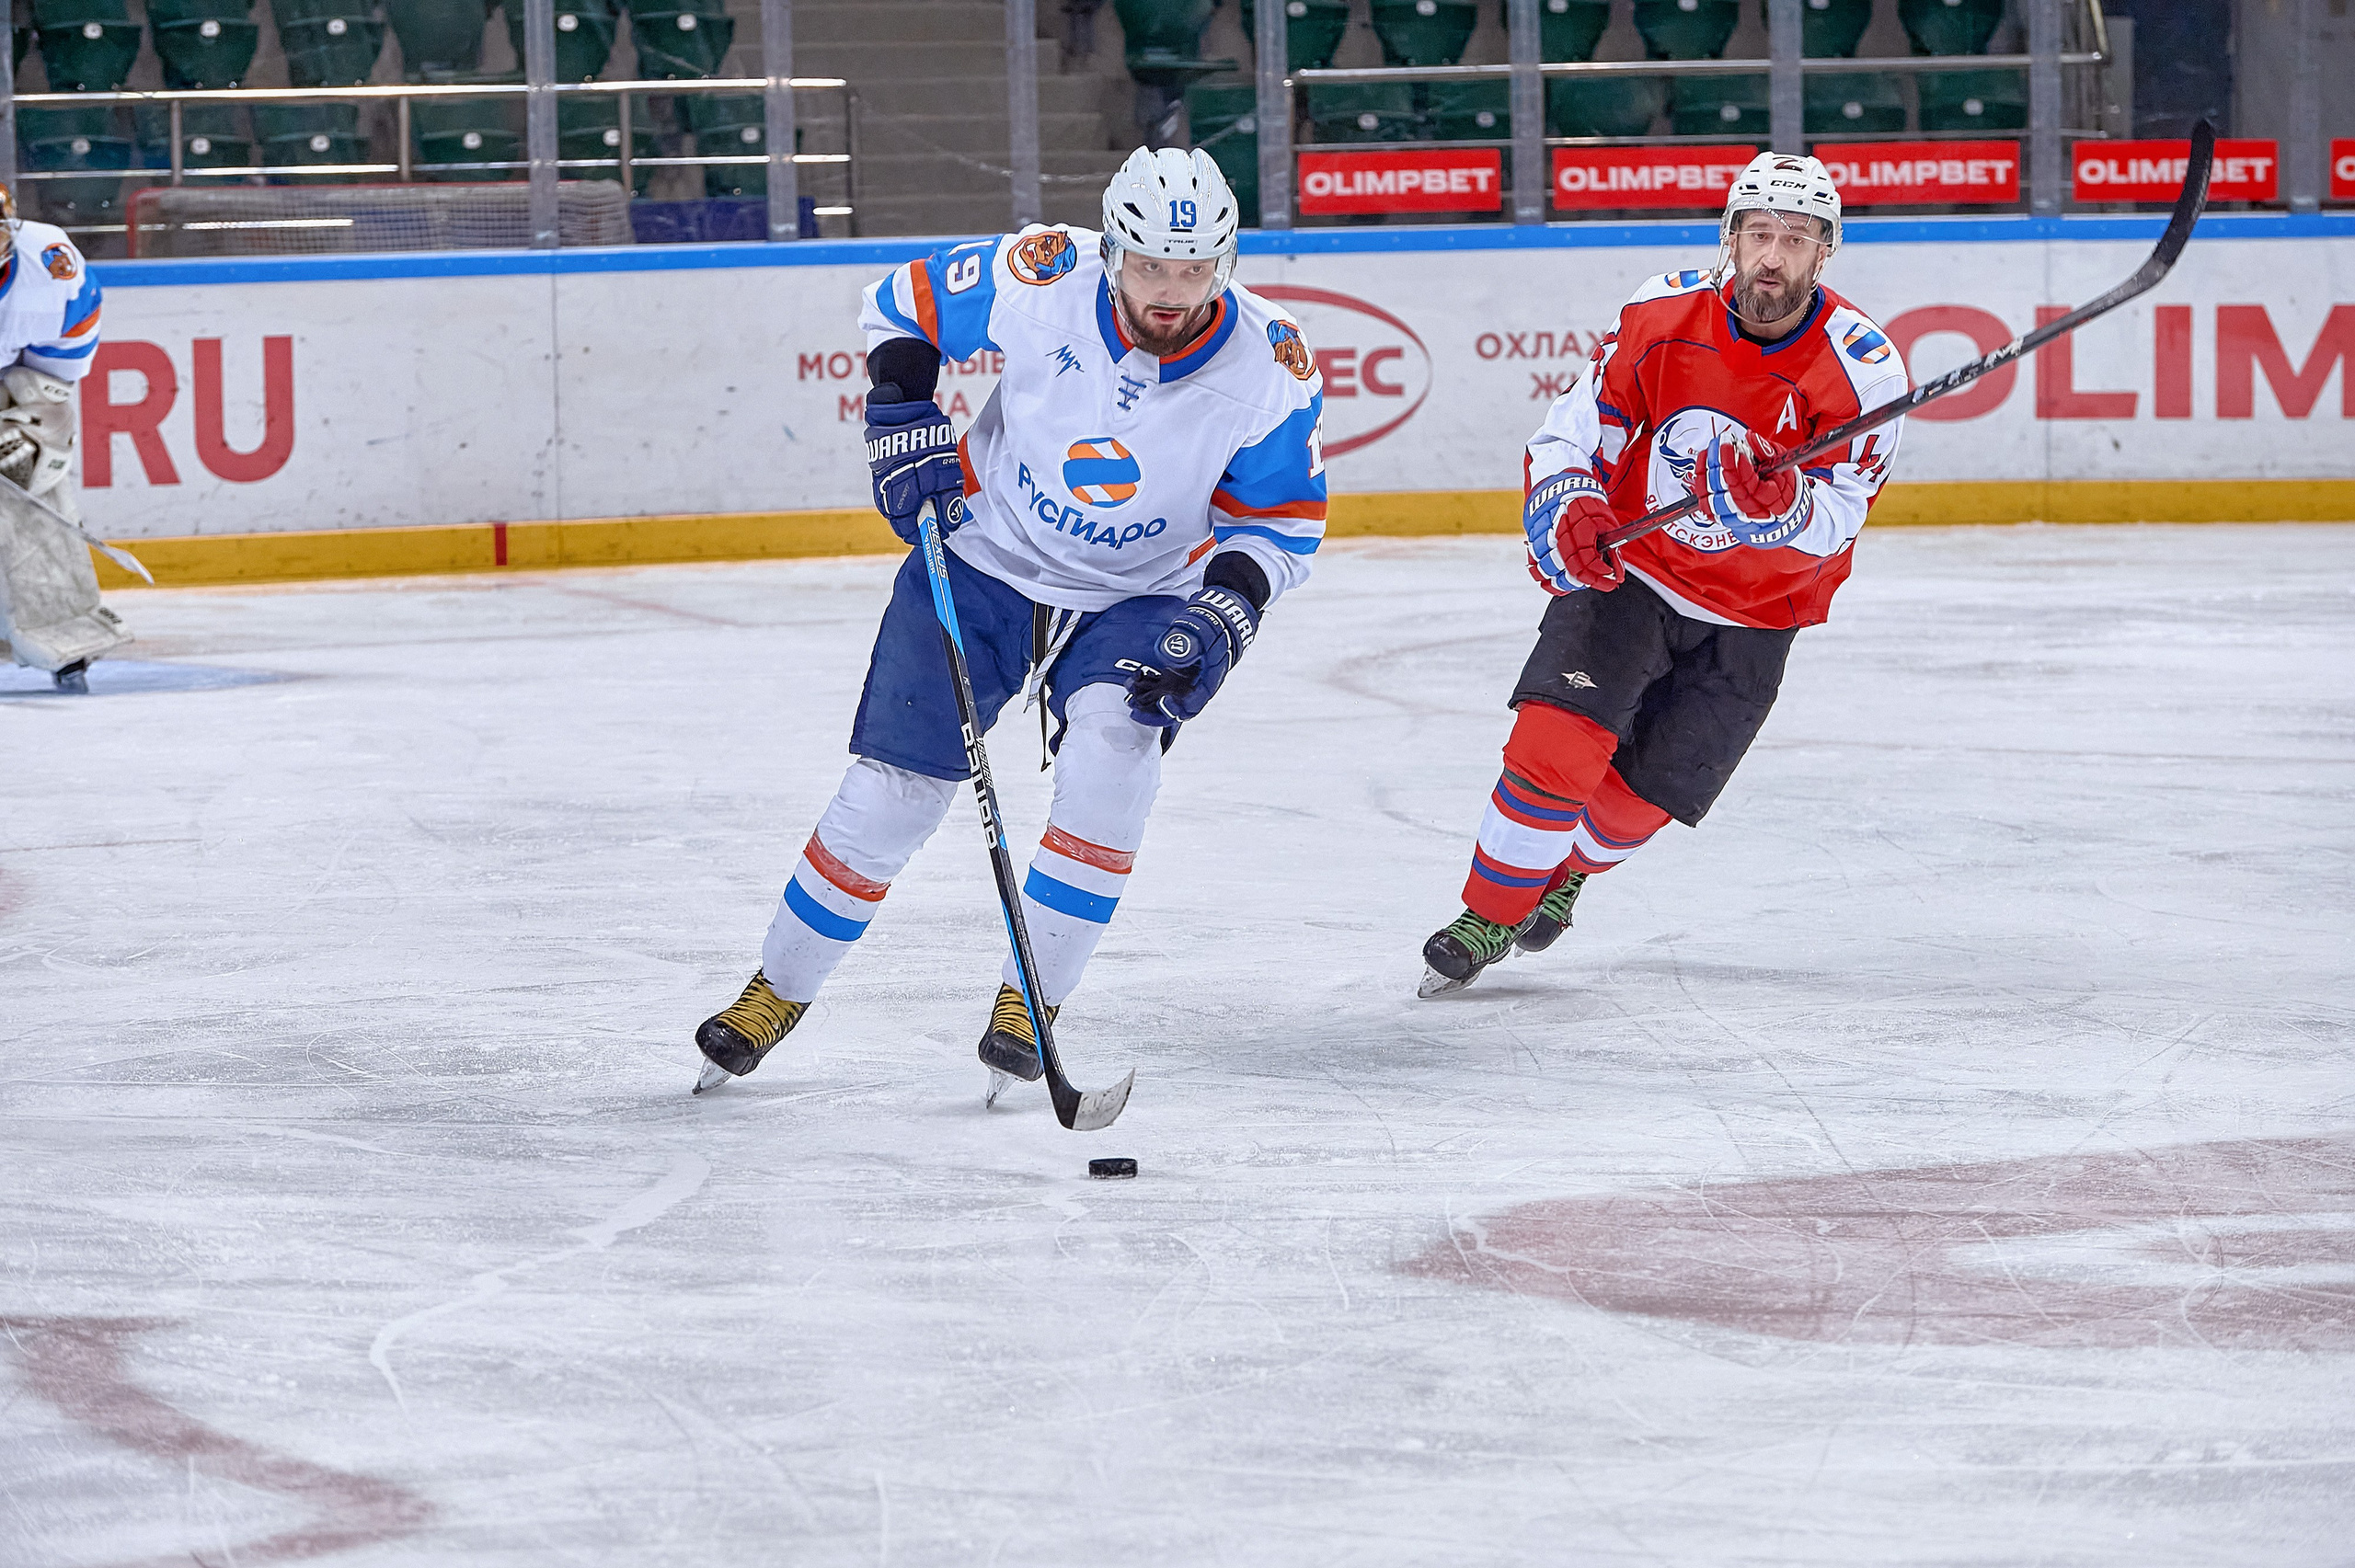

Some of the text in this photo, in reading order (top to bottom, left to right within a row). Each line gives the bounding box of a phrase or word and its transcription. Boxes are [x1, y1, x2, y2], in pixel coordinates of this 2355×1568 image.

[1304, 167, 1495, 196] OLIMPBET
[1770, 180, 1807, 189] CCM
[1826, 160, 2014, 187] OLIMPBET
[1169, 200, 1197, 227] 19
[928, 519, 949, 580] NEXUS
